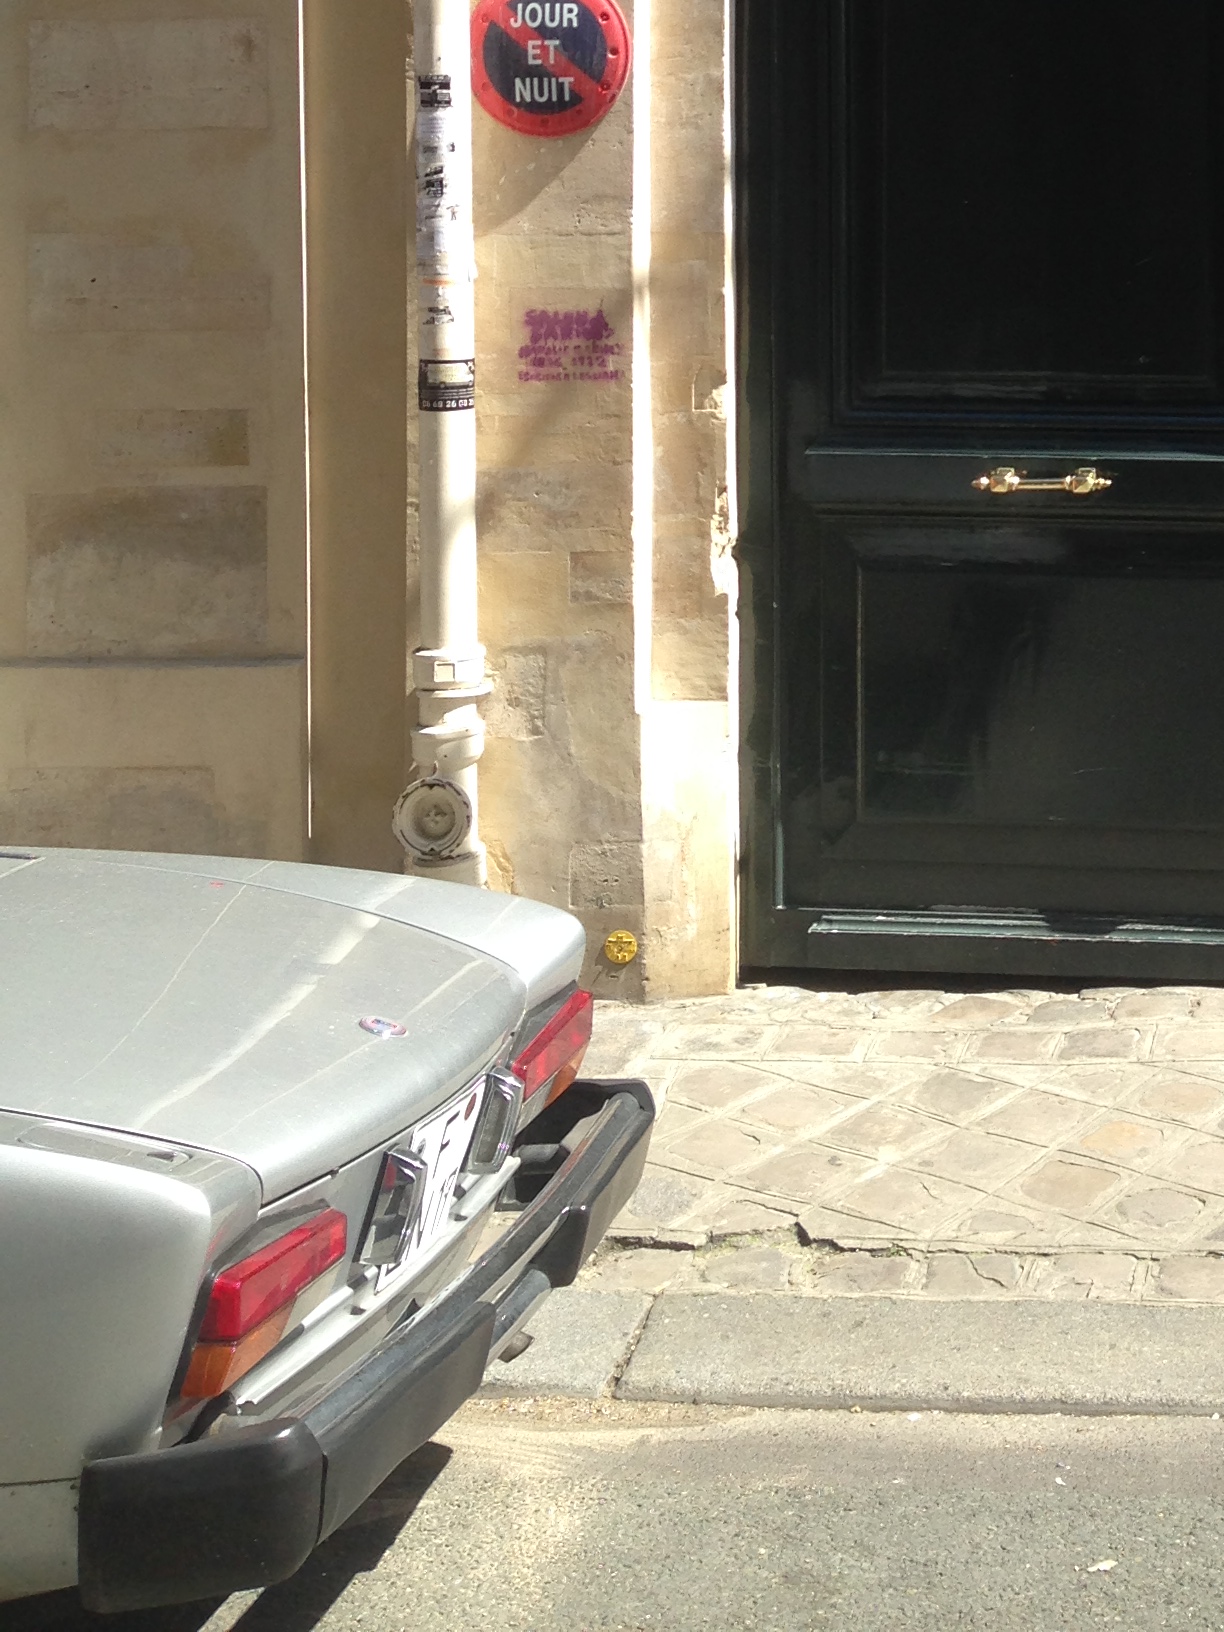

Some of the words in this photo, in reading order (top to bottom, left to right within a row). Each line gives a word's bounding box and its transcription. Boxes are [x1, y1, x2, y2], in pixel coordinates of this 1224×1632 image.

[510, 2, 579, 28] JOUR
[527, 40, 560, 65] ET
[514, 77, 574, 103] NUIT
[432, 1110, 460, 1179] F
